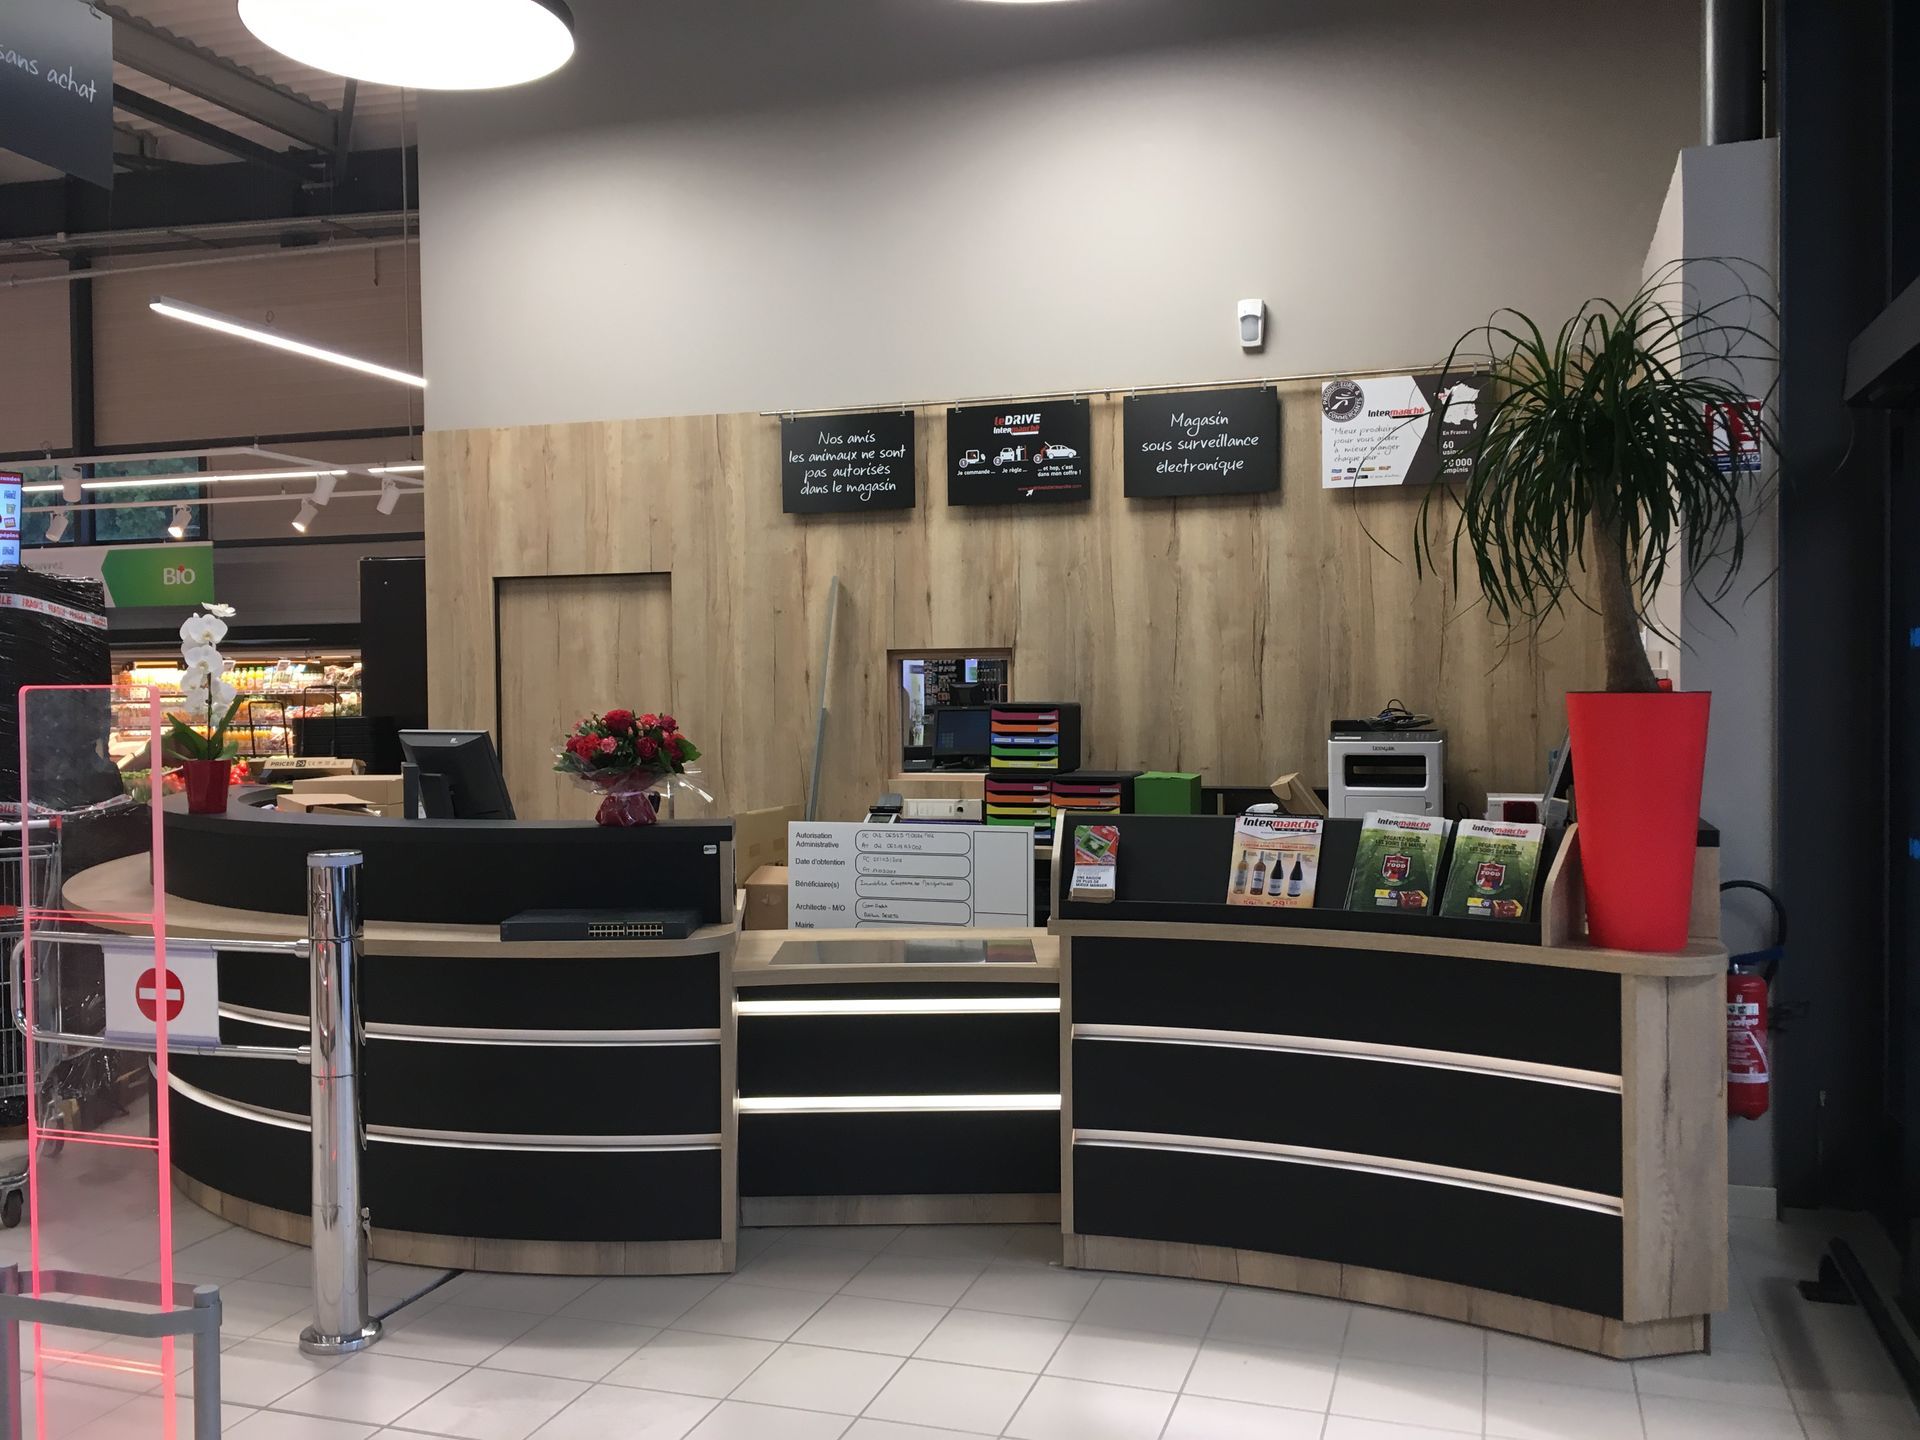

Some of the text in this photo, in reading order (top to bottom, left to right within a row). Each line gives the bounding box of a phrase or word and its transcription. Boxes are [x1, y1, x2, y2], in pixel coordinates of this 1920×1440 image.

[47, 66, 97, 103] achat
[1170, 411, 1229, 436] Magasin
[818, 430, 876, 444] Nos amis
[1142, 433, 1259, 452] sous surveillance
[1333, 437, 1355, 447] pour
[1443, 441, 1454, 449] 60
[788, 444, 906, 463] les animaux ne sont
[804, 462, 891, 484] pas autorisés
[1156, 457, 1244, 476] électronique
[800, 478, 896, 501] dans le magasin
[1243, 817, 1319, 831] Intermarché
[1378, 818, 1431, 830] Intermarché
[795, 841, 840, 849] Administrative
[811, 858, 846, 866] d'obtention
[795, 880, 840, 889] Bénéficiaire(s)
[795, 903, 827, 911] Architecte
[795, 921, 815, 929] Mairie
